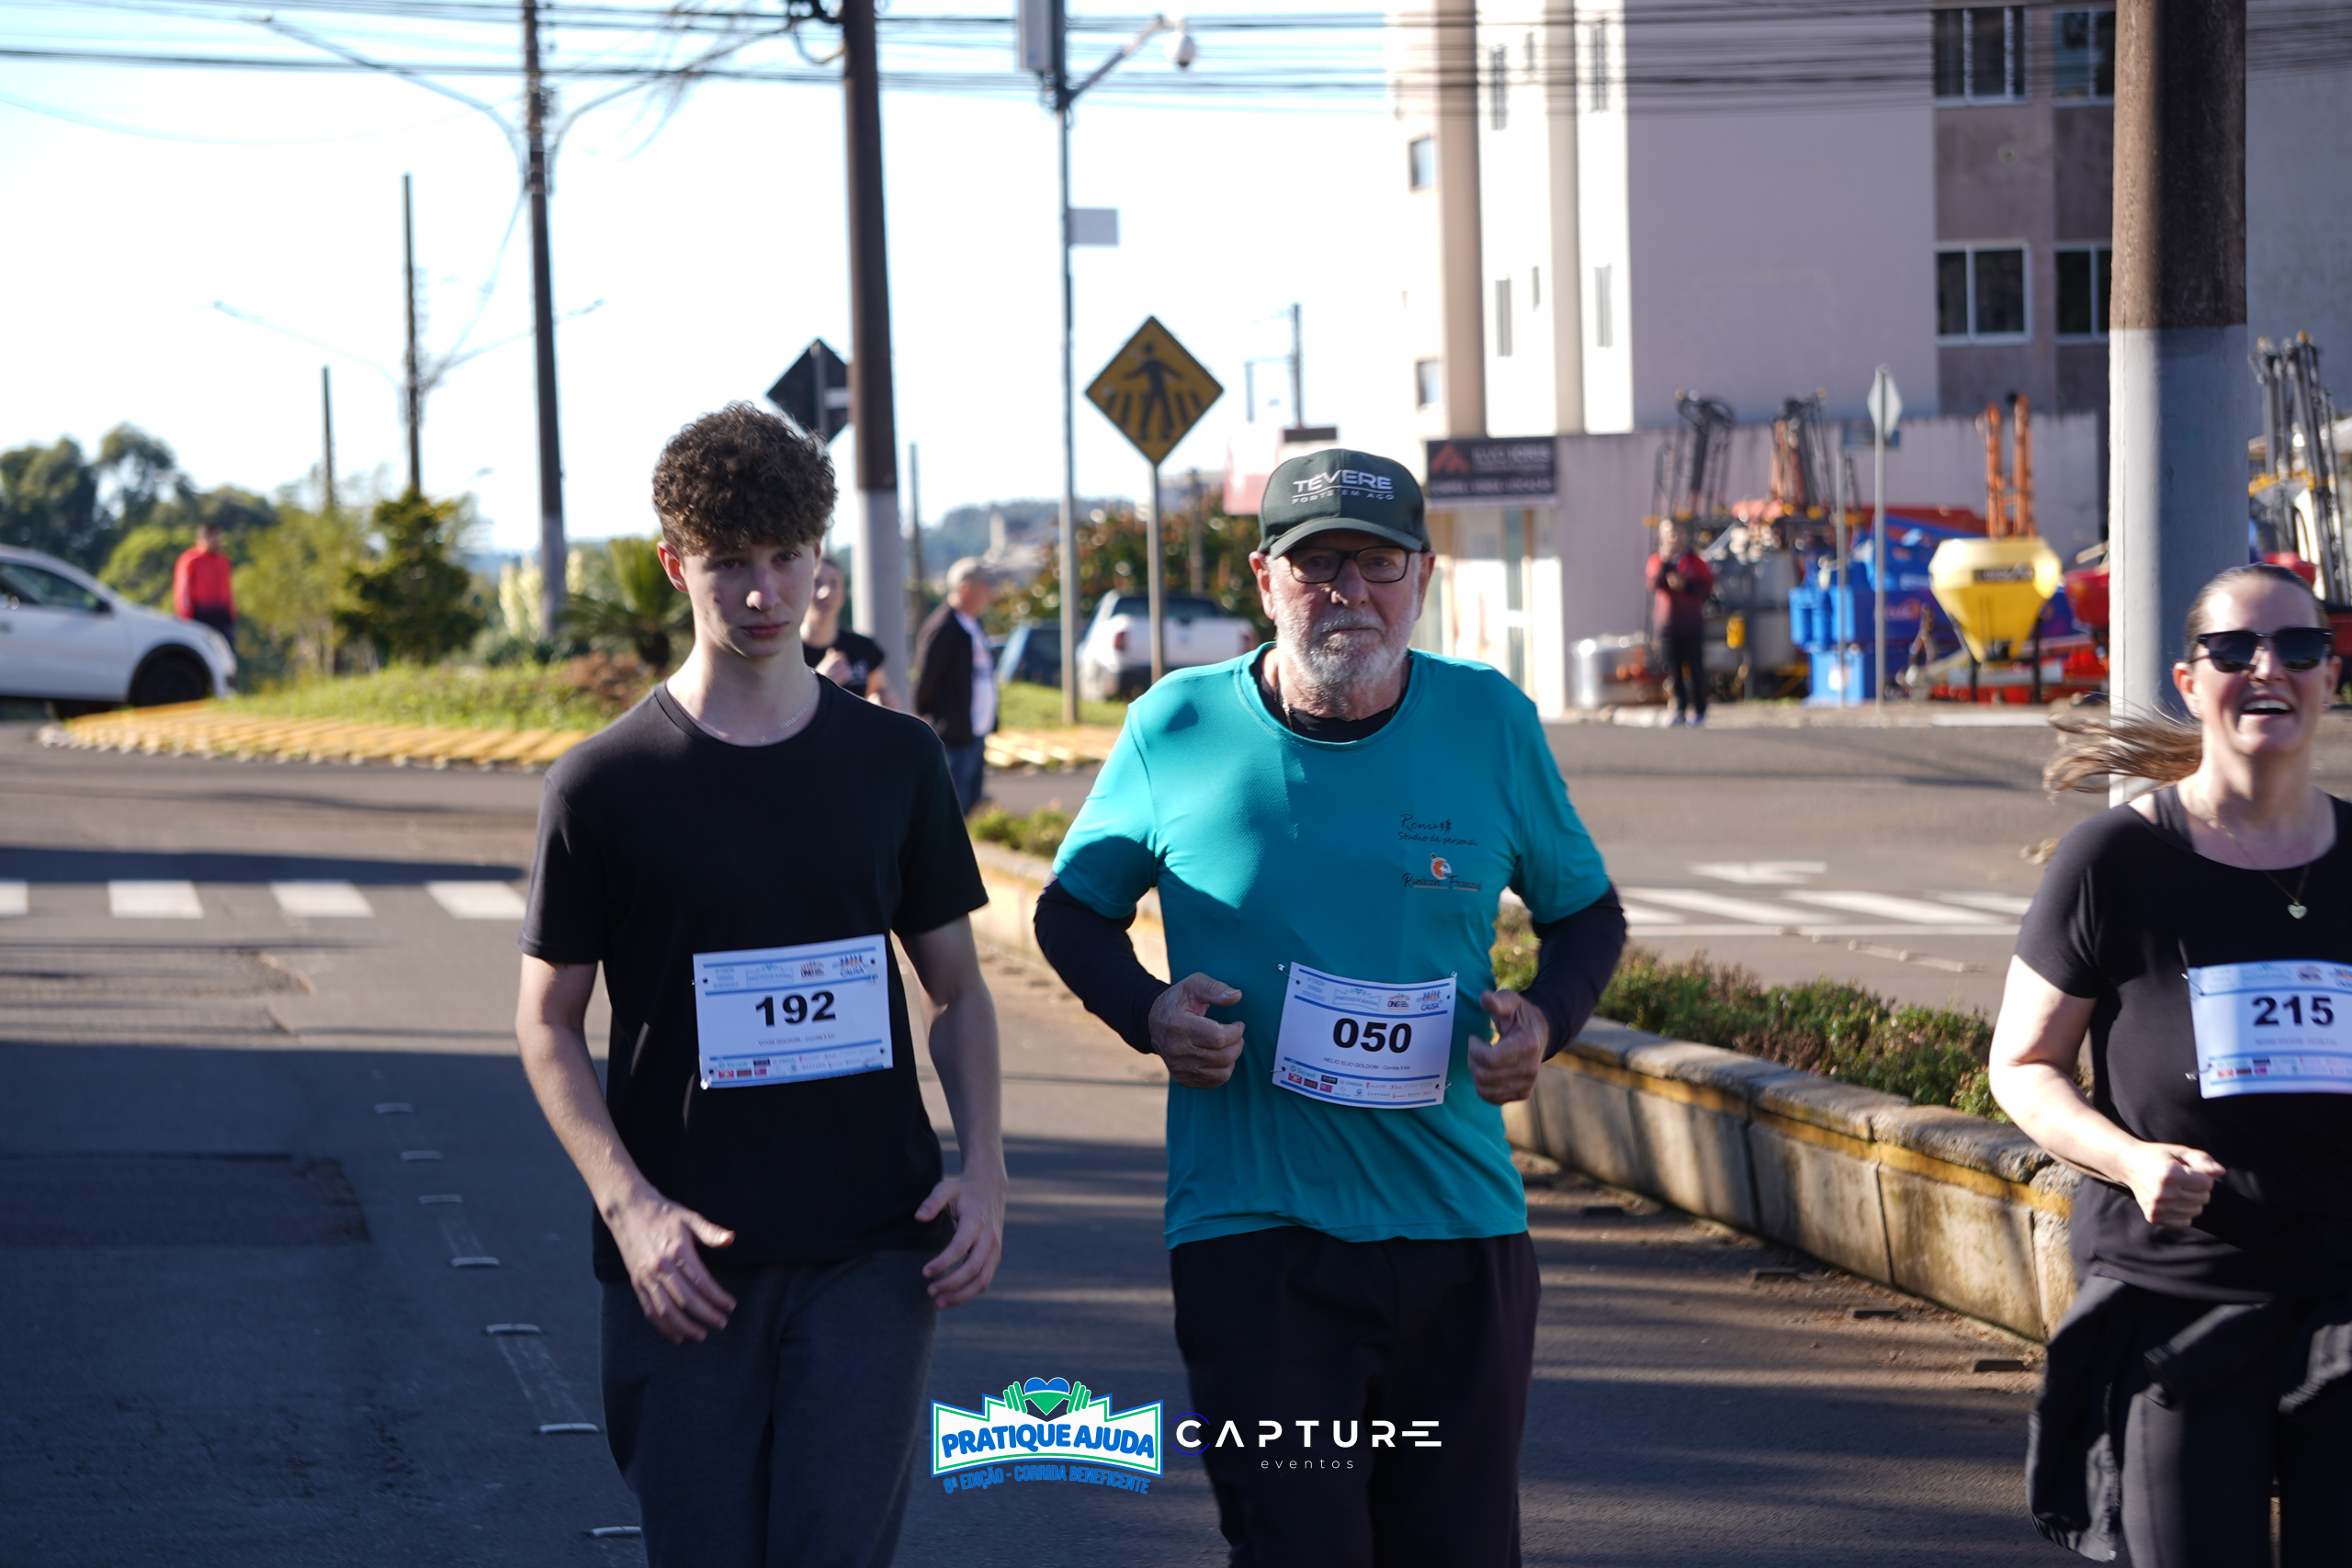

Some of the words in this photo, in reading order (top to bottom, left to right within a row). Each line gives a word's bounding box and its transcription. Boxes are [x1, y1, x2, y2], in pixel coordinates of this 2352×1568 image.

[1291, 490, 1334, 505] FORTE
[755, 990, 836, 1028] 192
[2252, 995, 2335, 1028] 215
[1333, 1018, 1412, 1054] 050
